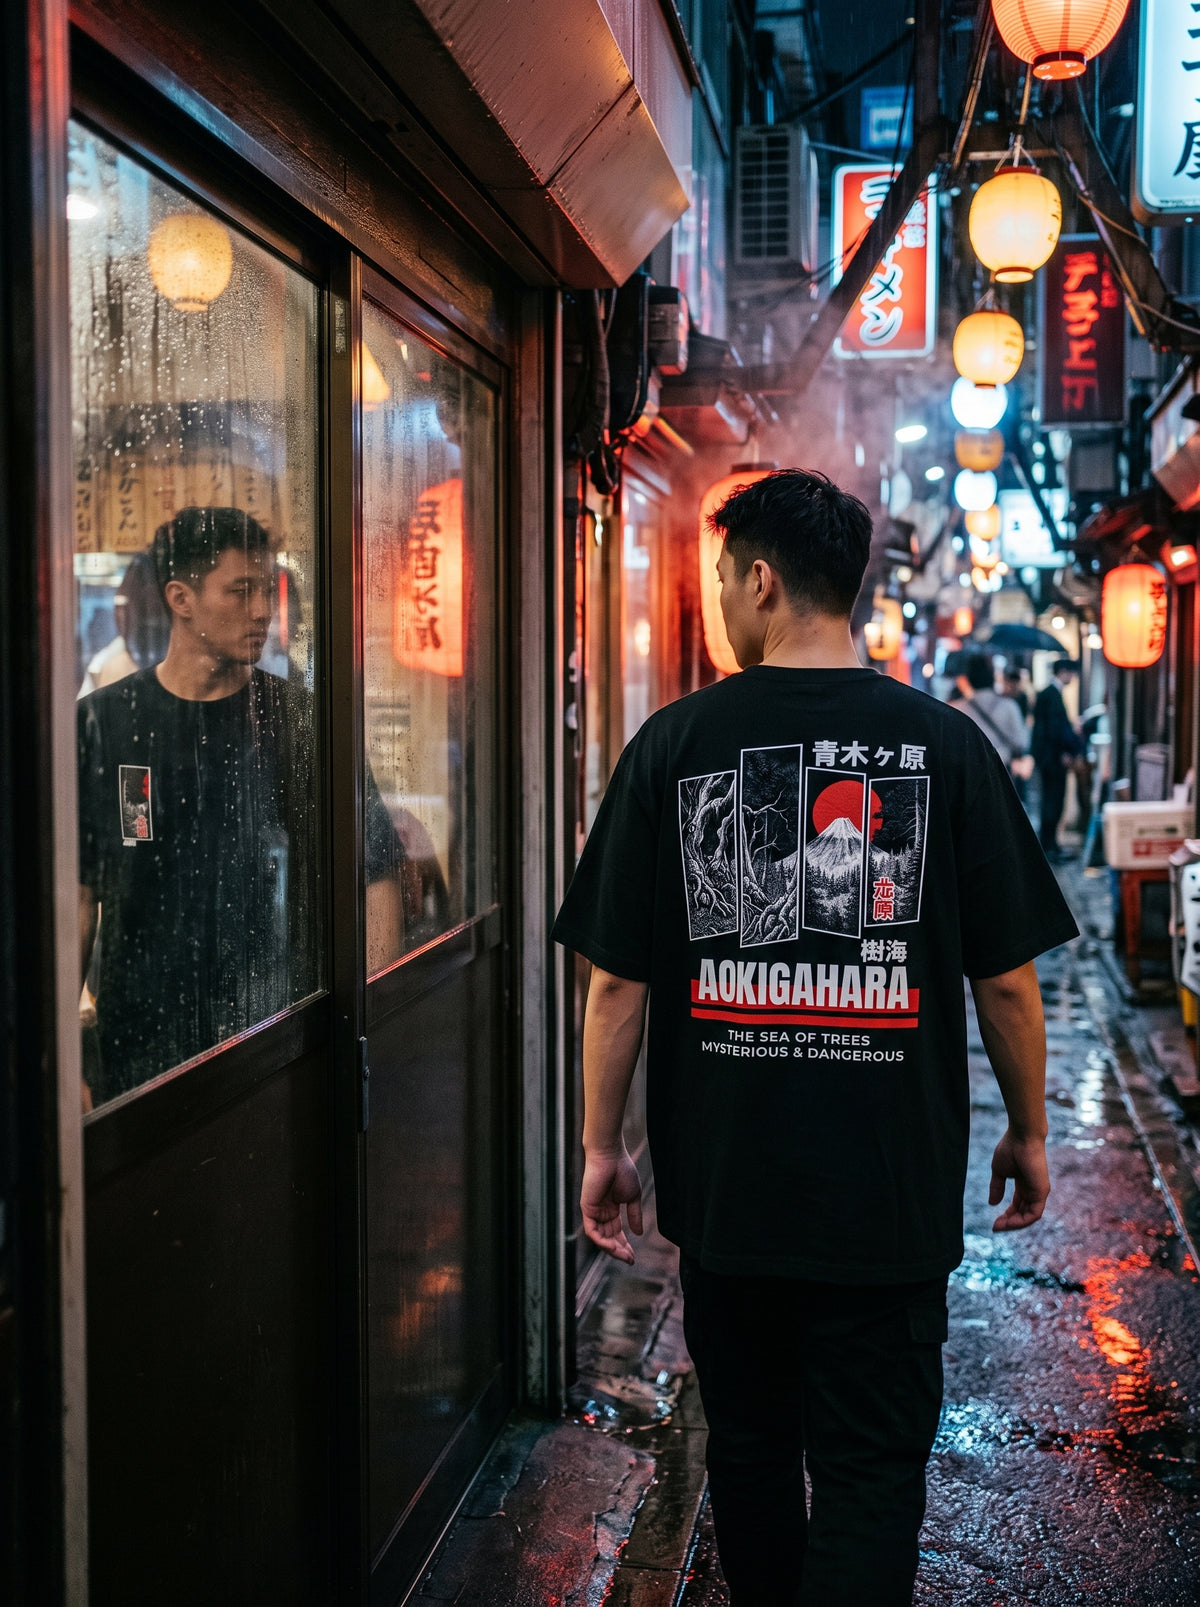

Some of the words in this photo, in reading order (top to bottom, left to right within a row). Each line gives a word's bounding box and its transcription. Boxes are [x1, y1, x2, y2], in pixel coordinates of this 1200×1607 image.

[860, 939, 908, 963] 樹海
[698, 958, 909, 1010] AOKIGAHARA
[728, 1029, 755, 1042] THE
[760, 1031, 790, 1043] SEA
[795, 1032, 817, 1043] OF
[821, 1034, 871, 1046] TREES
[701, 1041, 789, 1058] MYSTERIOUS
[793, 1047, 803, 1058] &
[808, 1048, 905, 1062] DANGEROUS
